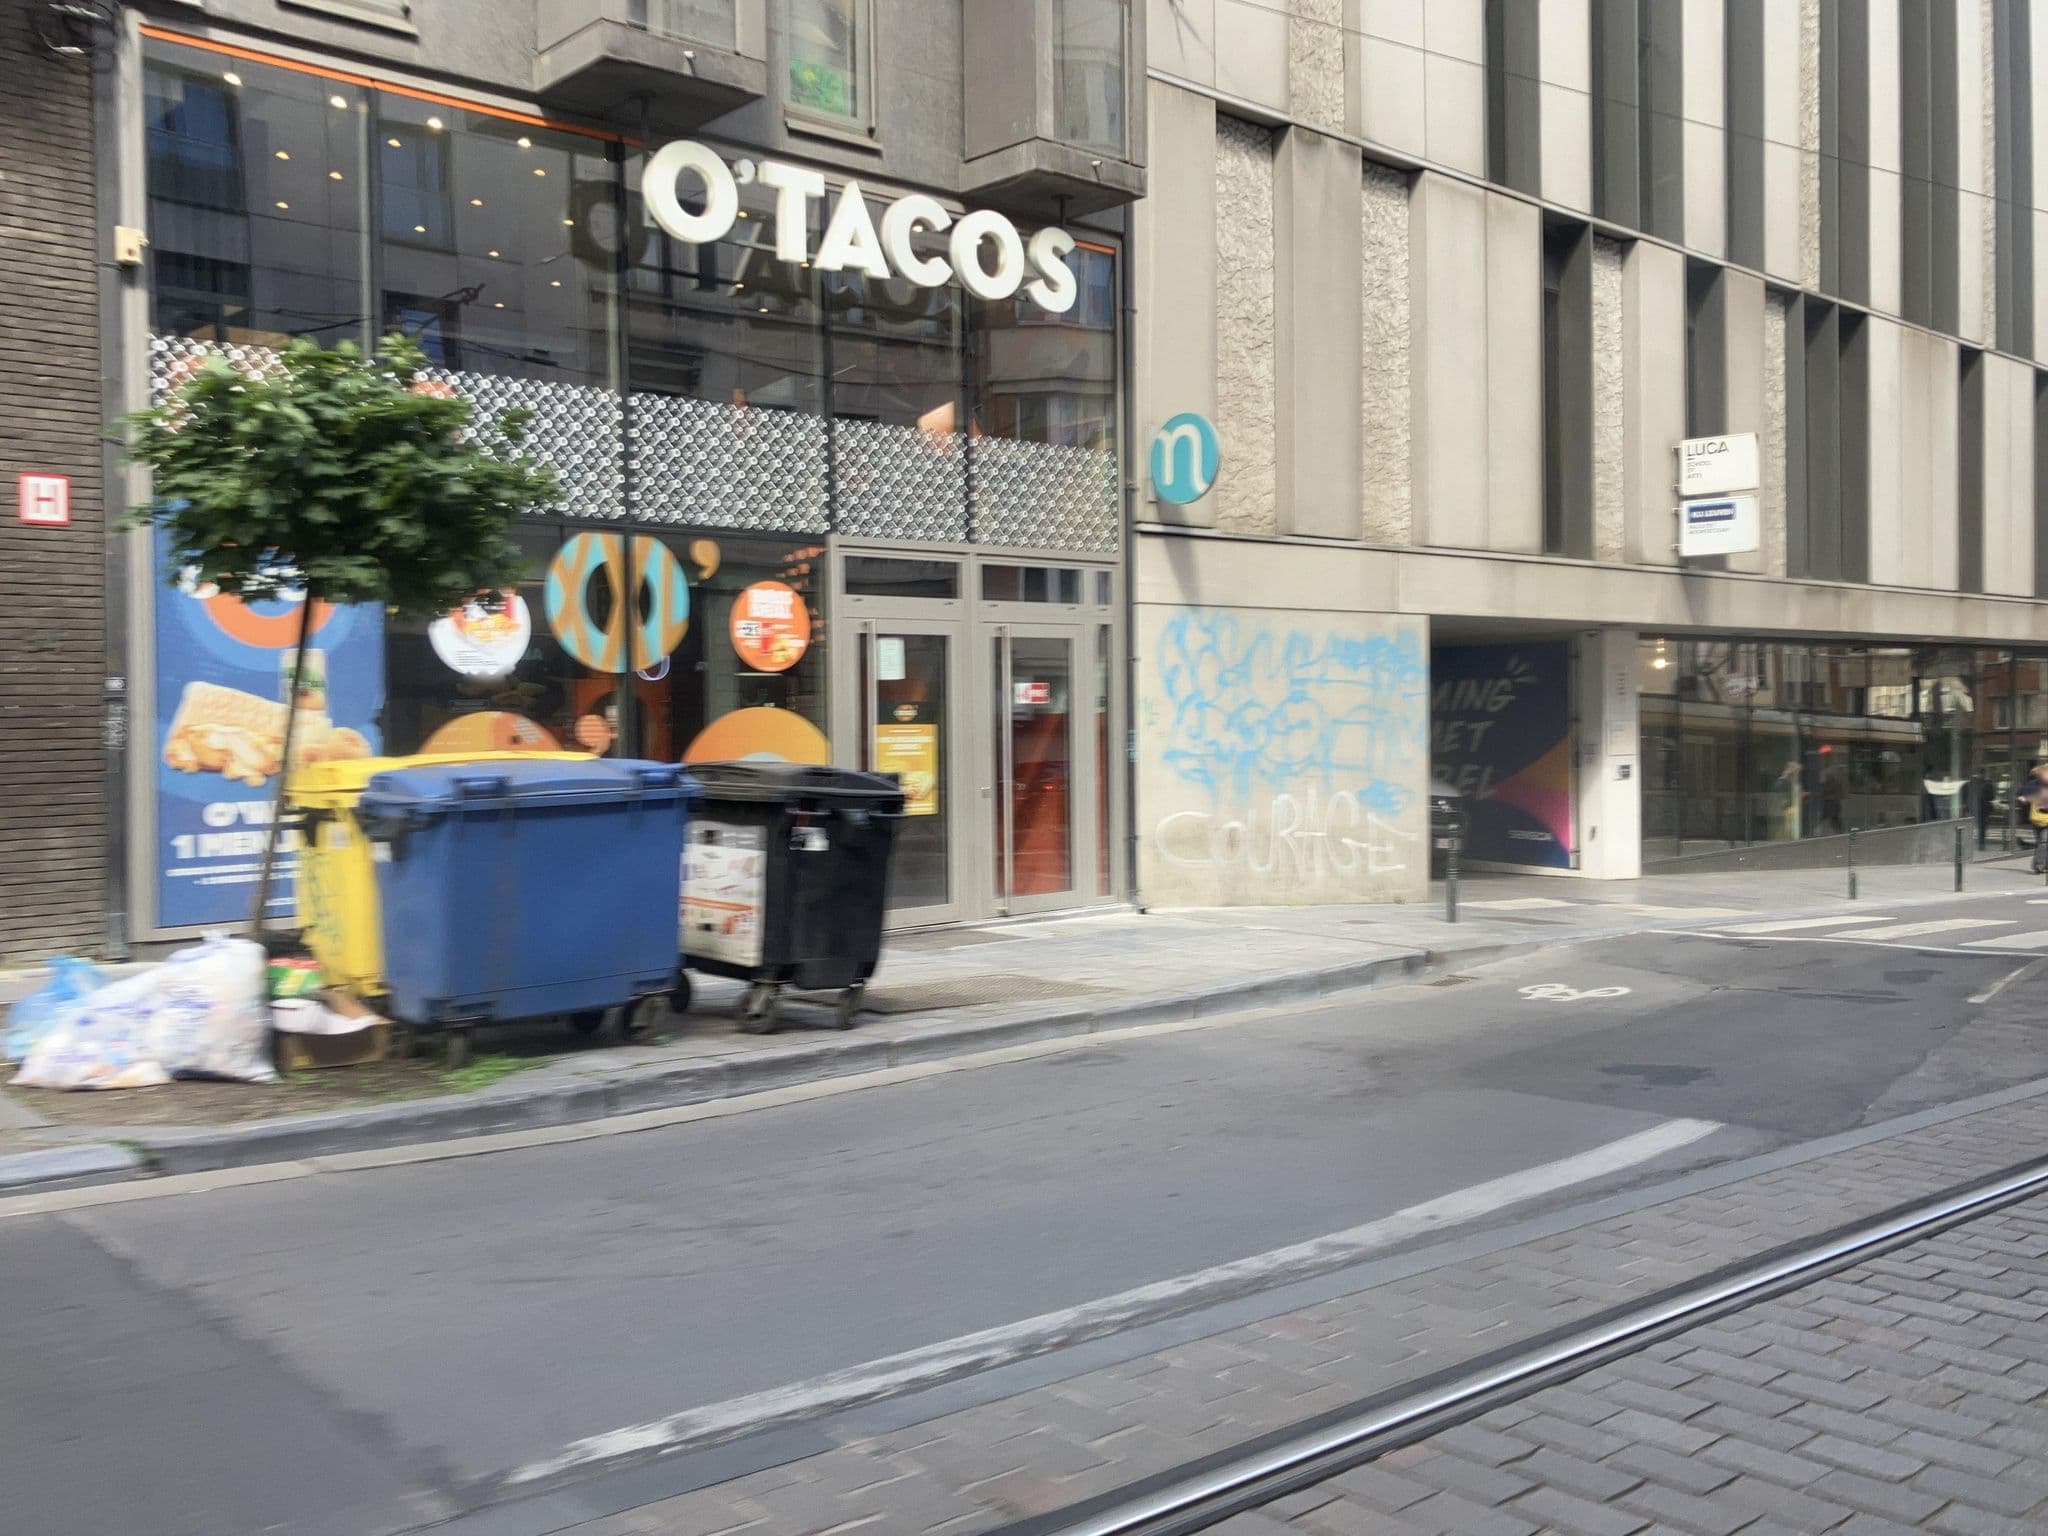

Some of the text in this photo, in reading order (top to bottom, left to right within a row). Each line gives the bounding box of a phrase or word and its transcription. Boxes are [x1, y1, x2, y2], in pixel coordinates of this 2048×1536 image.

[642, 139, 1077, 314] O'TACOS
[1687, 441, 1729, 456] LUCA
[29, 481, 61, 515] H
[1155, 788, 1419, 878] COURAGE
